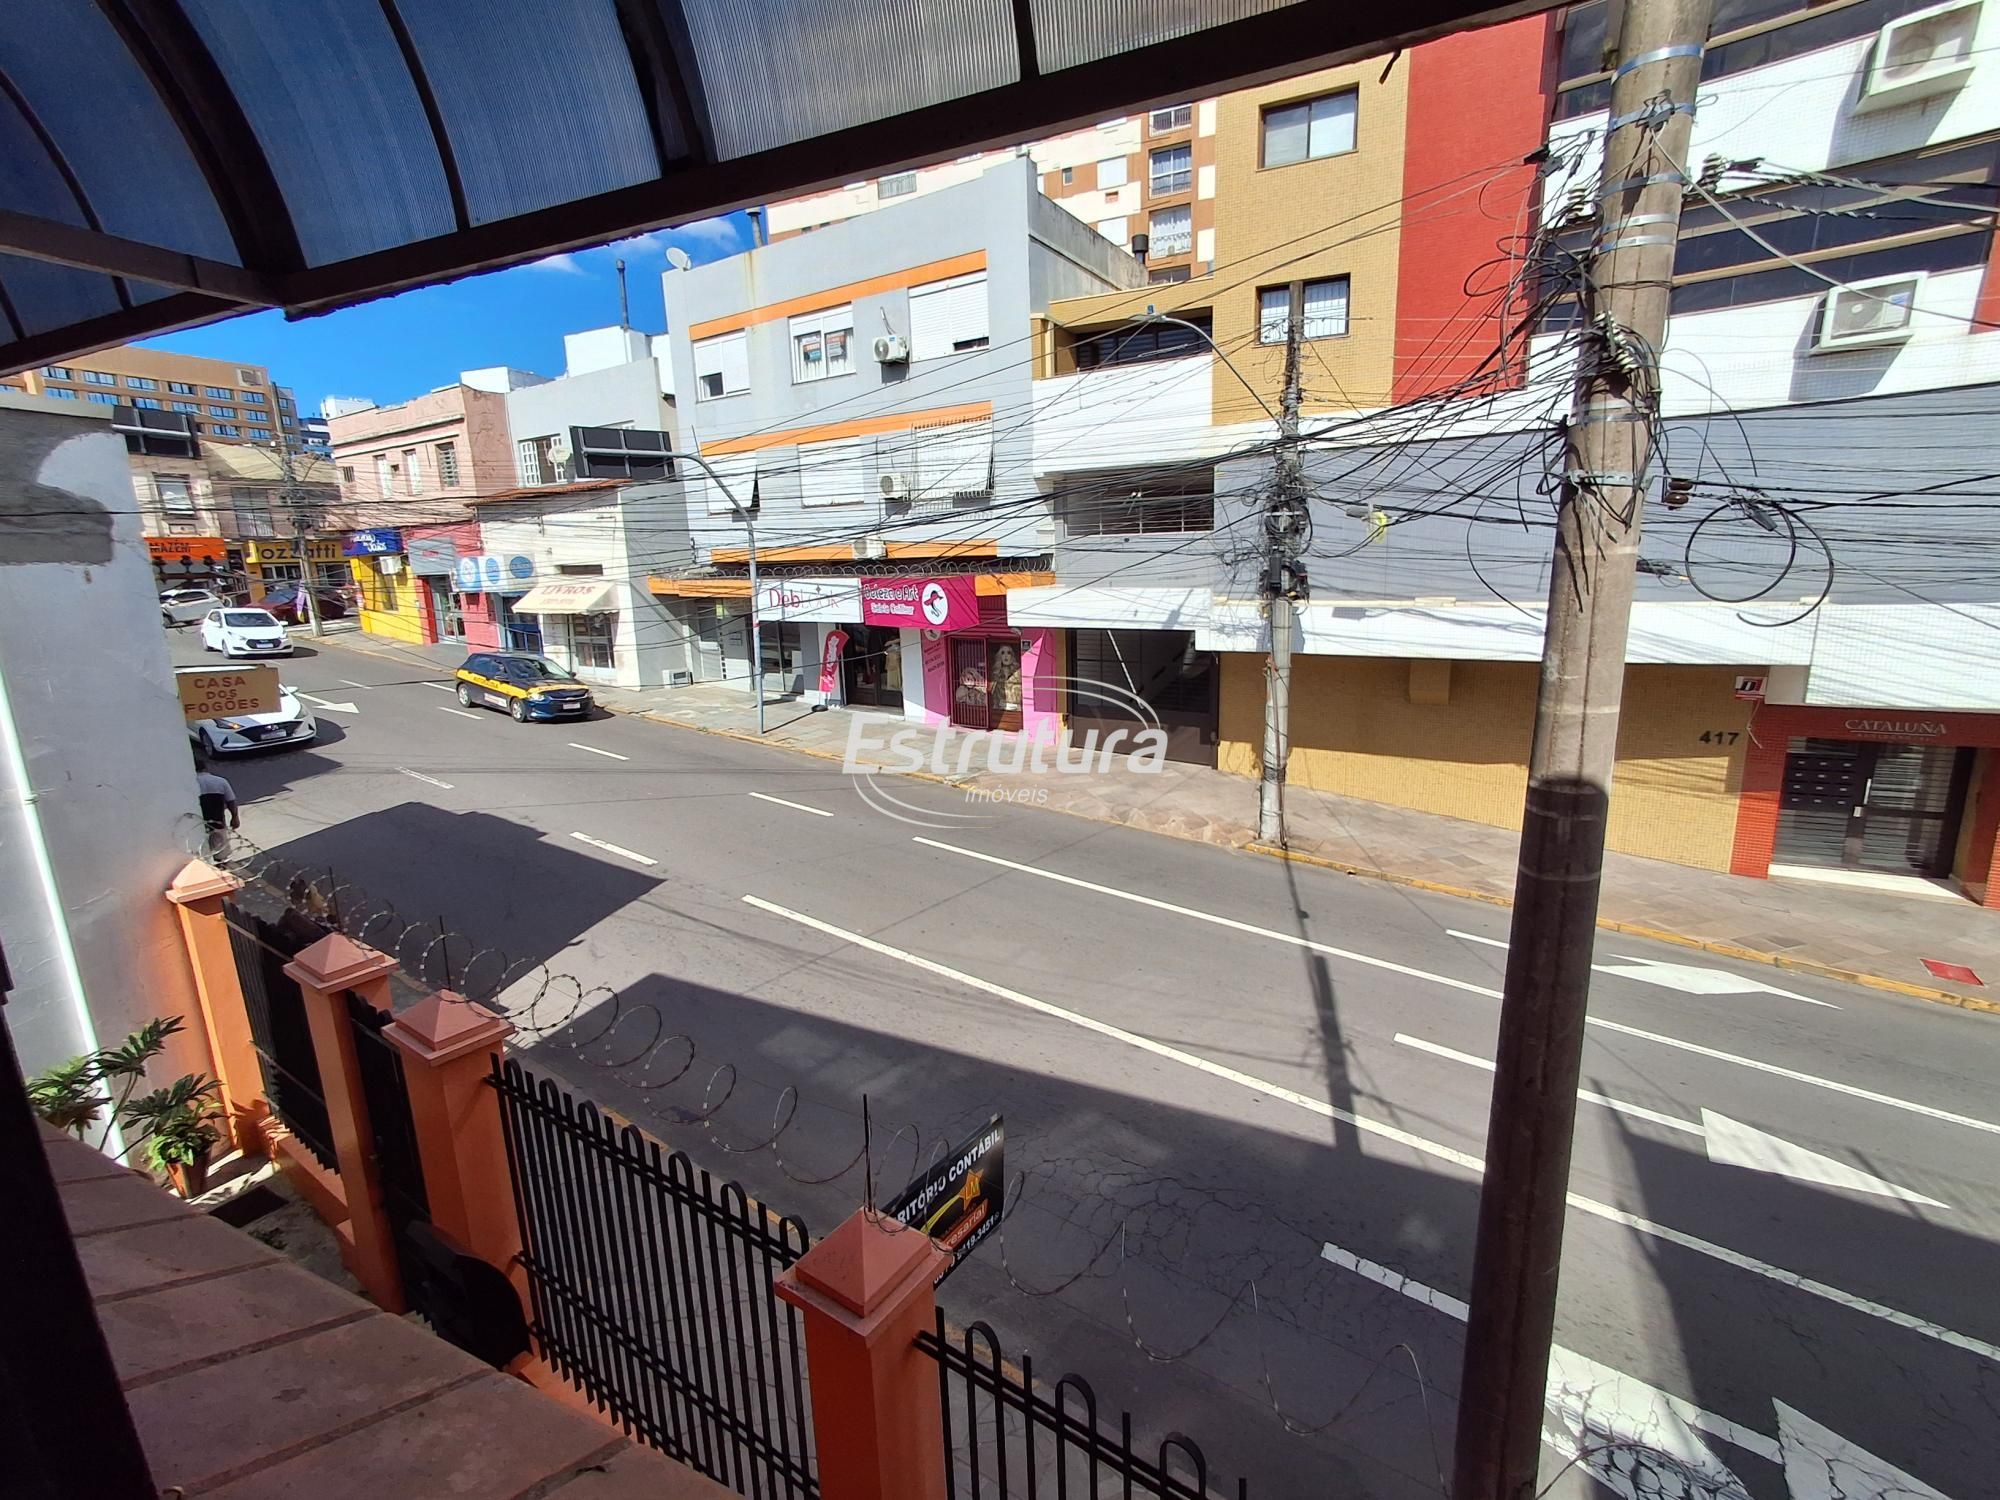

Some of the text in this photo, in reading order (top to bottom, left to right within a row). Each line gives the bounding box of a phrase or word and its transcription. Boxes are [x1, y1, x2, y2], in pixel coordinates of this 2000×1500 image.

[194, 676, 246, 689] CASA
[206, 689, 237, 700] DOS
[184, 697, 260, 714] FOGÕES
[1844, 719, 1947, 735] CATALUÑA
[1700, 731, 1739, 746] 417
[896, 1175, 946, 1224] RITÓRIO
[949, 1129, 1000, 1182] CONTÁBIL
[946, 1203, 986, 1246] resarial
